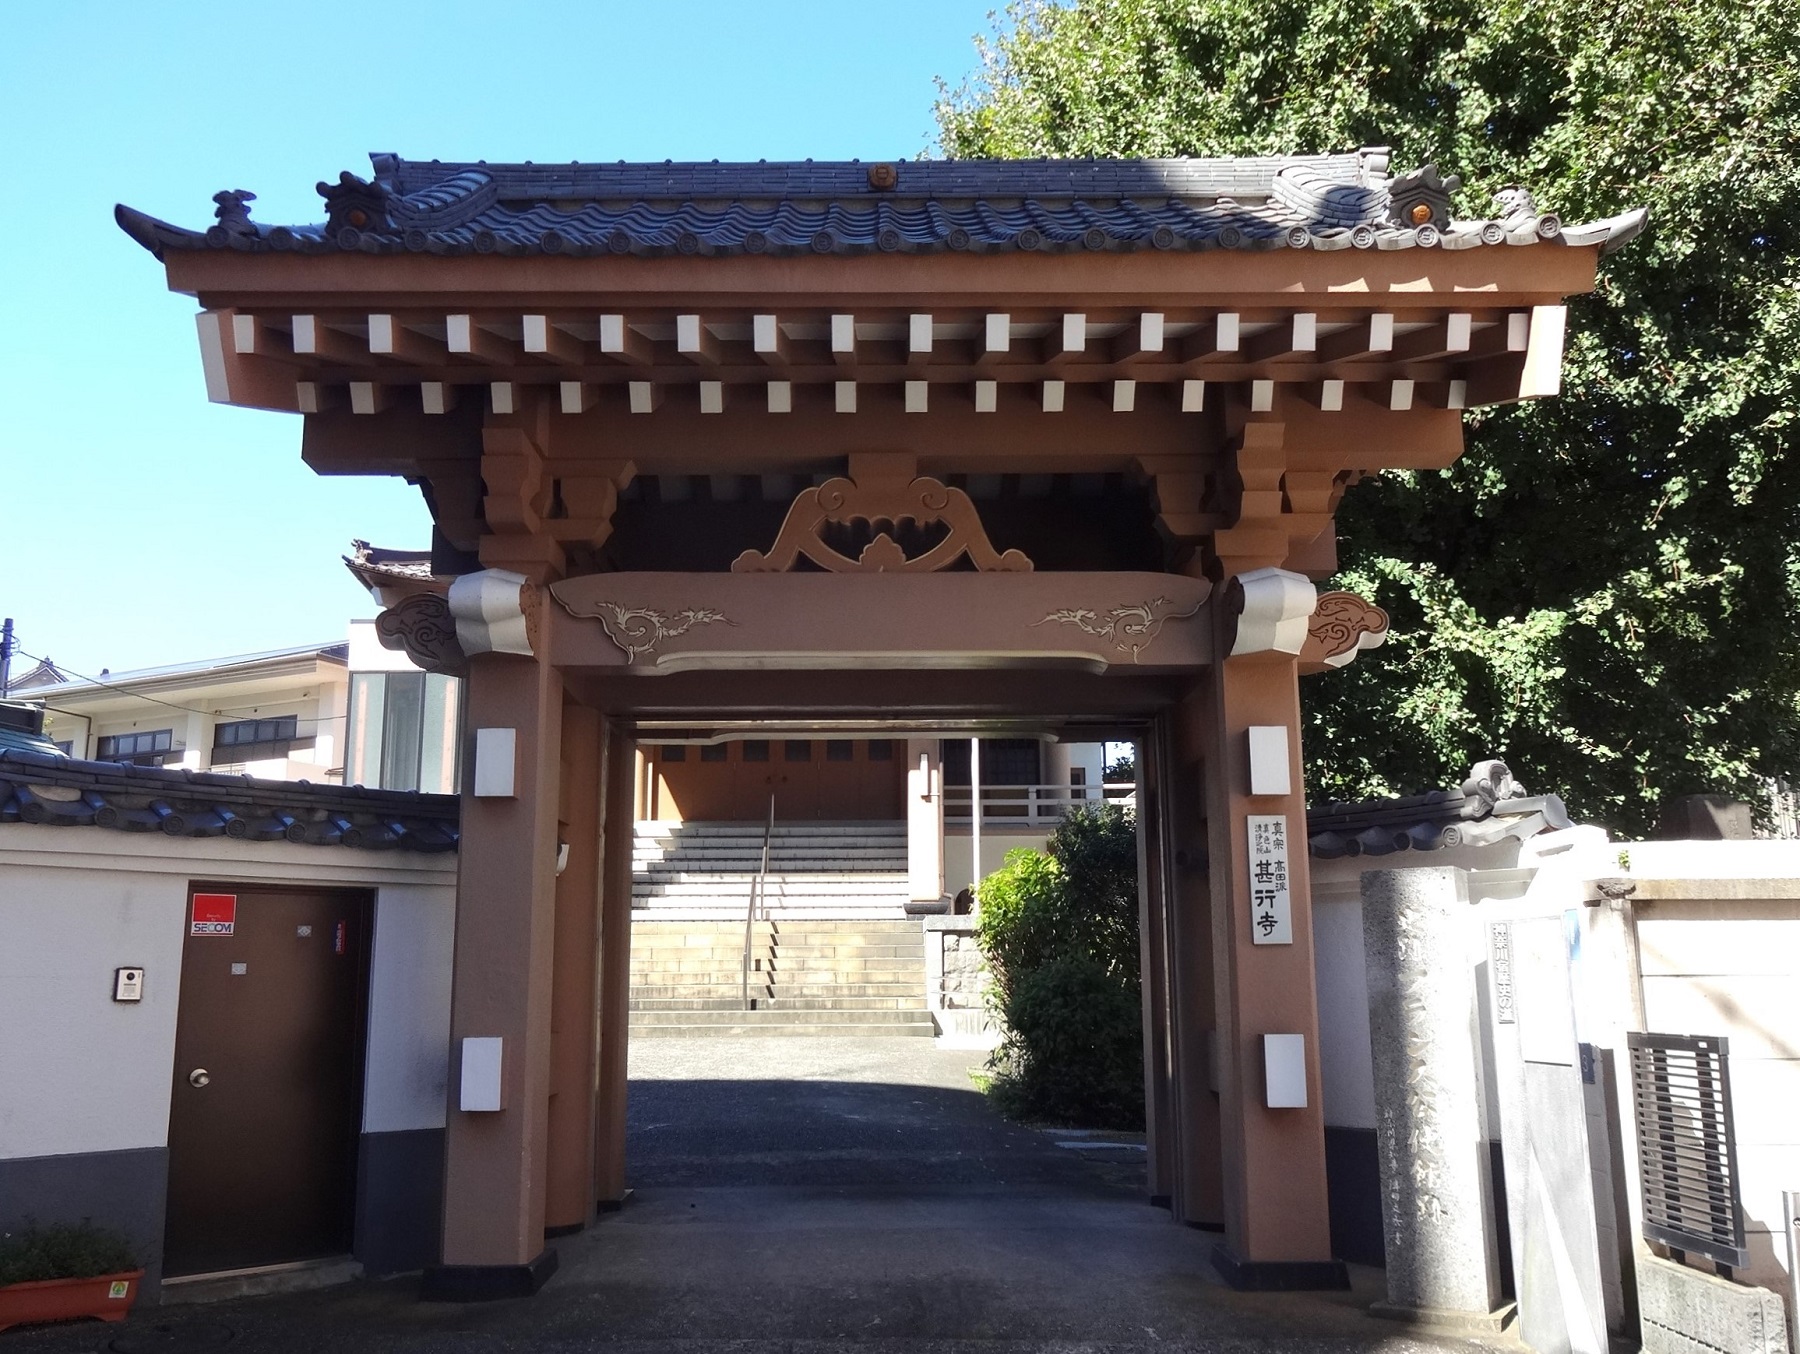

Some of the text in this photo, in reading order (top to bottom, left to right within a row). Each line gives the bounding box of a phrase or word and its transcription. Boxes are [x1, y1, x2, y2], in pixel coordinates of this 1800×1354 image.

[1262, 823, 1272, 854] 真色山
[1271, 820, 1285, 851] 真宗
[1254, 859, 1279, 937] 甚行寺
[194, 923, 232, 933] SECOM
[1492, 922, 1514, 1021] 神奈川宿歴史の道
